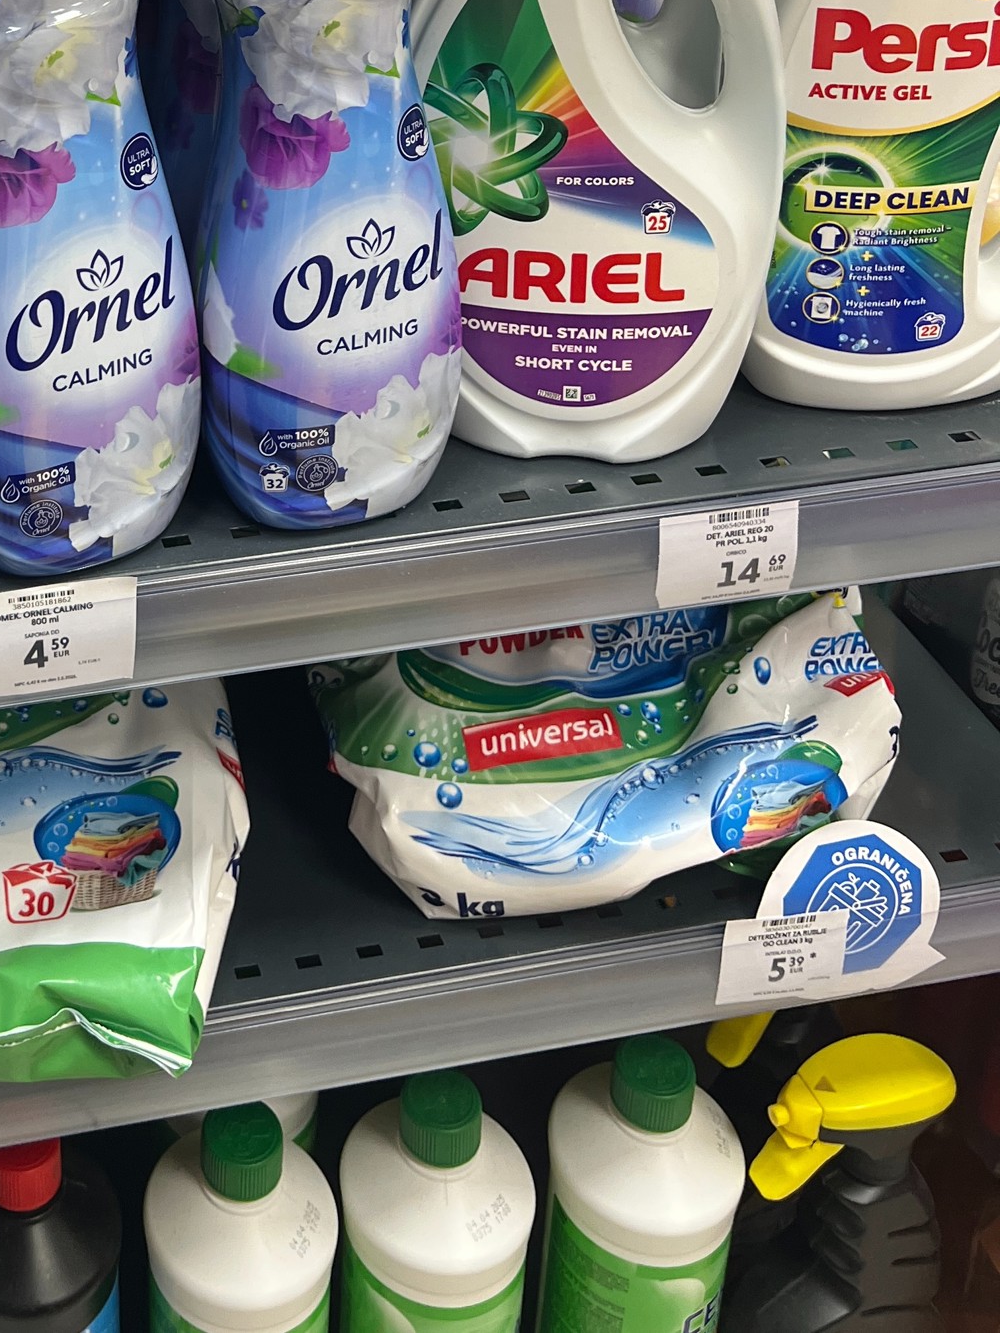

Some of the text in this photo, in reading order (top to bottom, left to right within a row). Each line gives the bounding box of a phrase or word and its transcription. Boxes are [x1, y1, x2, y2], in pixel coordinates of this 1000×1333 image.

[808, 83, 932, 101] ACTIVE GEL
[129, 158, 150, 176] SOFT
[556, 176, 634, 186] FOR COLORS
[814, 187, 969, 210] DEEP CLEAN
[648, 215, 667, 231] 25
[909, 225, 944, 235] removal
[272, 208, 443, 332] Ornel
[458, 247, 685, 304] ARIEL
[5, 235, 175, 373] Ornel
[316, 318, 419, 357] CALMING
[556, 325, 692, 340] STAIN REMOVAL
[921, 326, 938, 336] 22
[552, 344, 597, 353] EVEN IN
[52, 348, 153, 393] CALMING
[515, 356, 632, 372] SHORT CYCLE
[294, 428, 329, 439] 100%
[279, 440, 315, 449] Organic
[37, 466, 69, 482] 100%
[22, 480, 57, 494] Organic
[266, 479, 283, 488] 32
[725, 530, 746, 538] ARIEL
[717, 554, 786, 588] 14 69
[23, 602, 94, 618] ORNEL CALMING
[31, 617, 47, 625] 800
[24, 637, 70, 669] 4 59
[54, 650, 70, 658] EUR
[481, 712, 613, 757] universal
[831, 846, 913, 916] OGRANIČENA
[19, 887, 55, 918] 30
[748, 931, 791, 942] DETERDŽENT
[768, 957, 804, 982] 5 39
